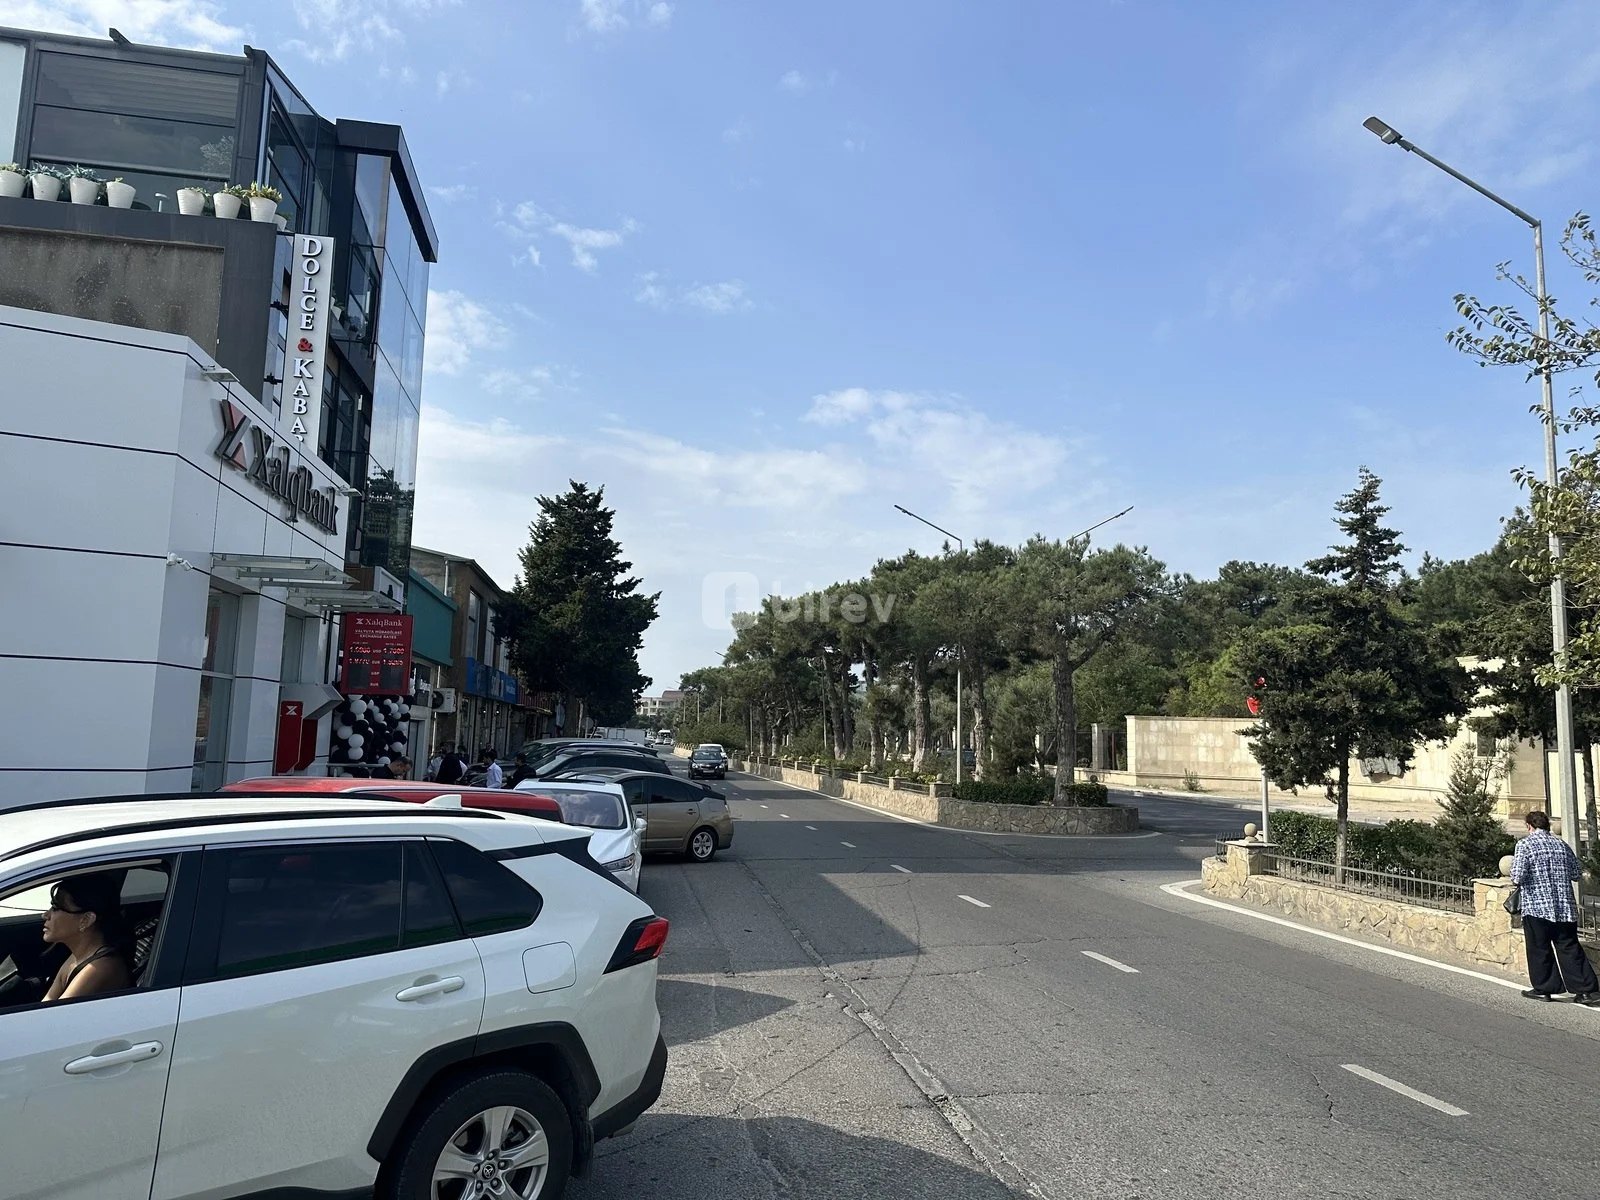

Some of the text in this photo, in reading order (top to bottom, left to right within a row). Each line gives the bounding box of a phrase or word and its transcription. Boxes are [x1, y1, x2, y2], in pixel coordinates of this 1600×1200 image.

[290, 237, 323, 442] DOLCE & KABA
[245, 424, 339, 536] XalqBank
[365, 618, 402, 627] XalqBank
